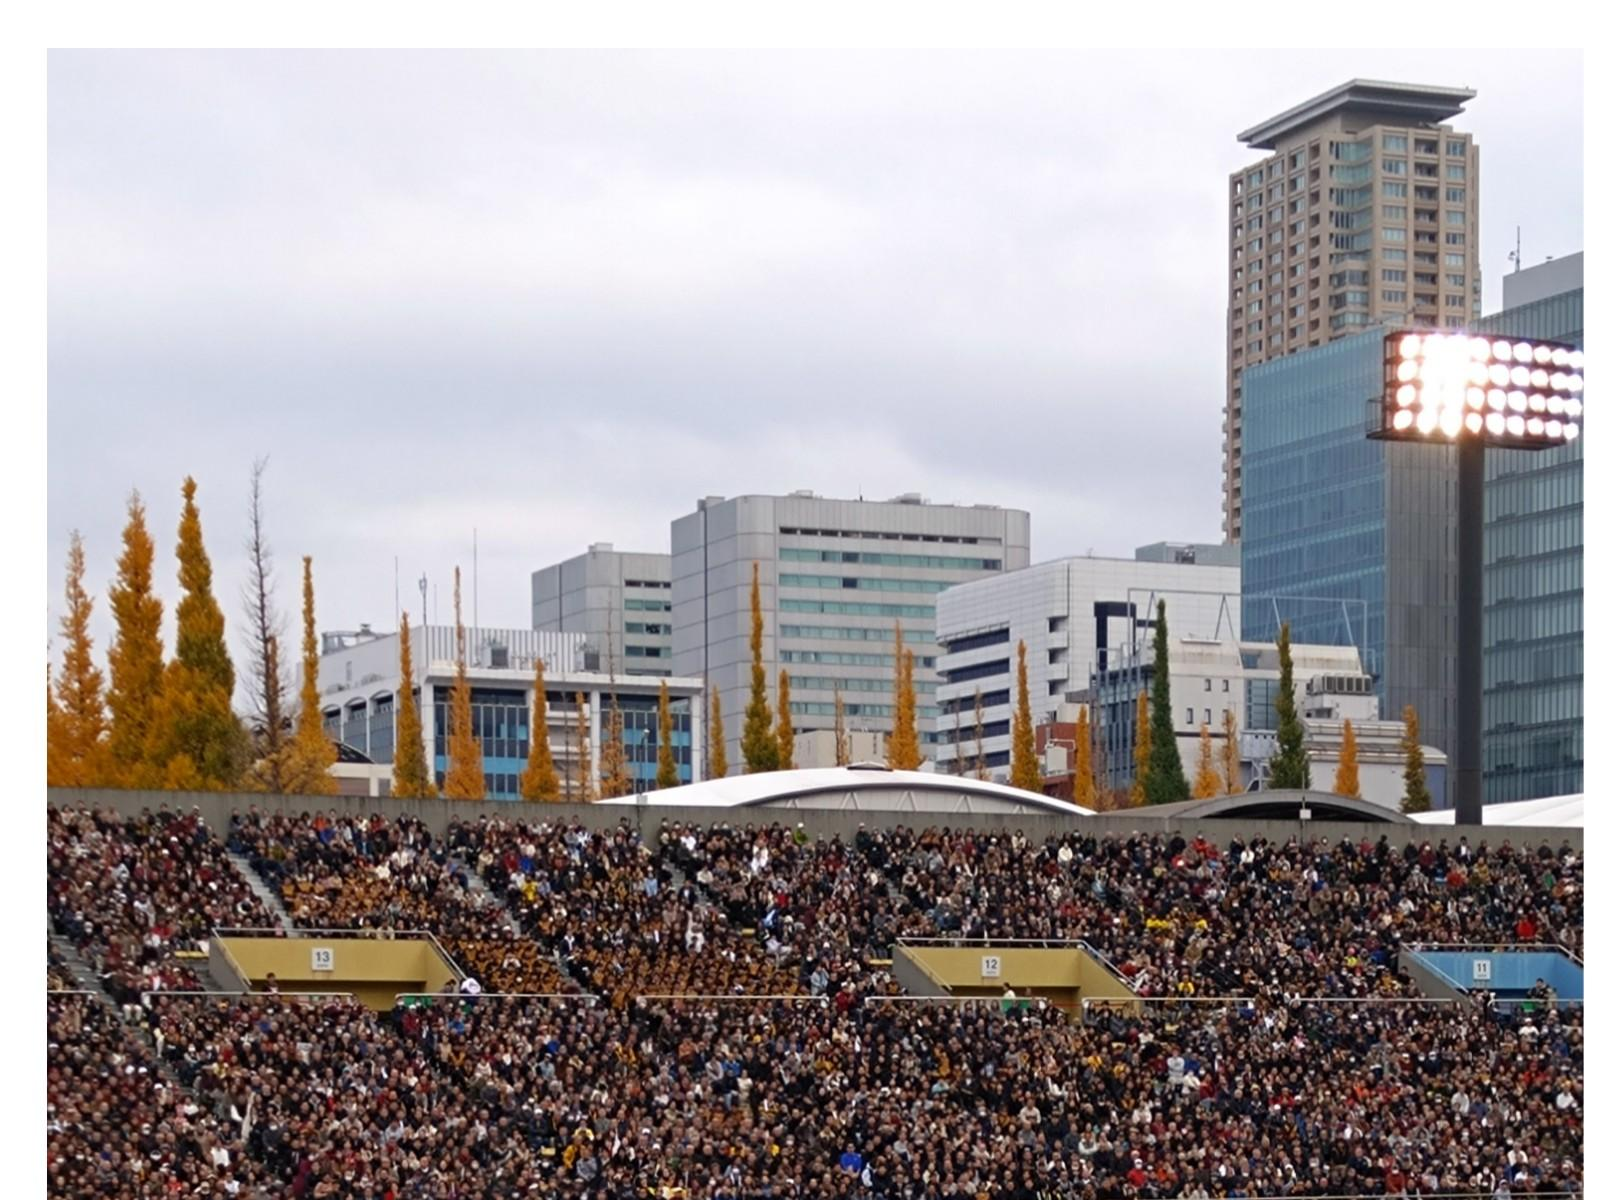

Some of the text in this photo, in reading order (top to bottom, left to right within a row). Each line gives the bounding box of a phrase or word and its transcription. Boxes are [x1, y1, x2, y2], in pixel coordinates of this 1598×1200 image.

[315, 951, 330, 962] 13
[985, 959, 998, 969] 12
[1477, 963, 1487, 972] 11
